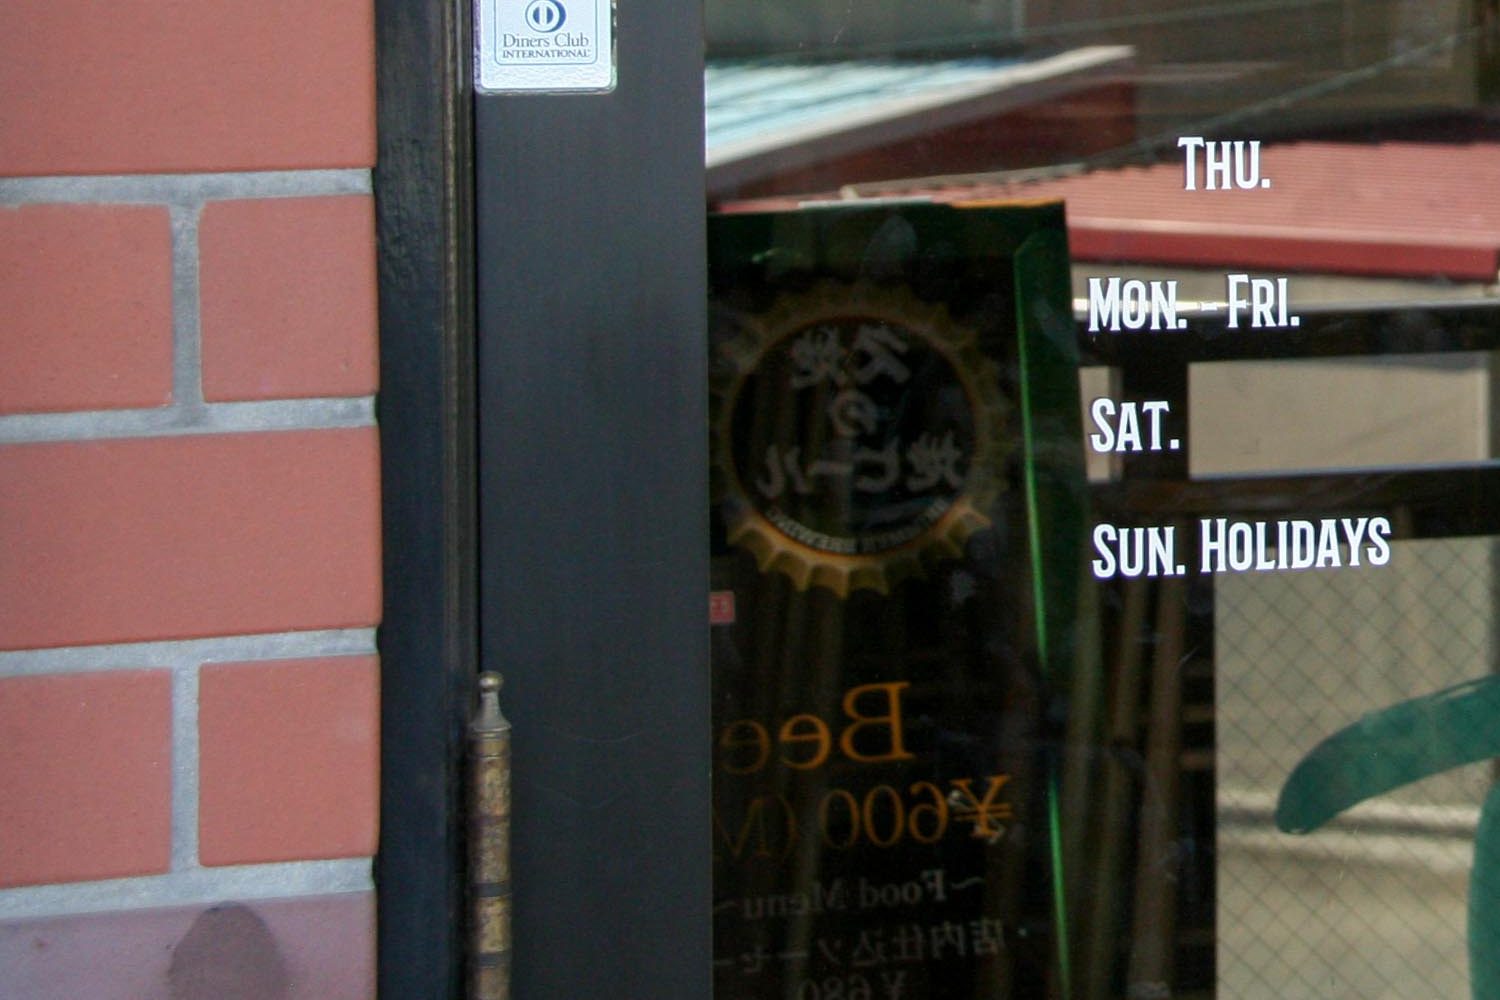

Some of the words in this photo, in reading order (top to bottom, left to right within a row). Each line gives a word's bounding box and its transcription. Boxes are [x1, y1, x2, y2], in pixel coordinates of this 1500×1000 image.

[502, 32, 550, 48] Diners
[553, 32, 590, 48] Club
[502, 48, 590, 59] INTERNATIONAL
[1177, 137, 1271, 191] THU.
[1088, 276, 1188, 332] MON.
[1226, 274, 1301, 329] FRI.
[1091, 398, 1180, 453] SAT.
[1092, 524, 1186, 579] SUN.
[1201, 516, 1391, 573] HOLIDAYS
